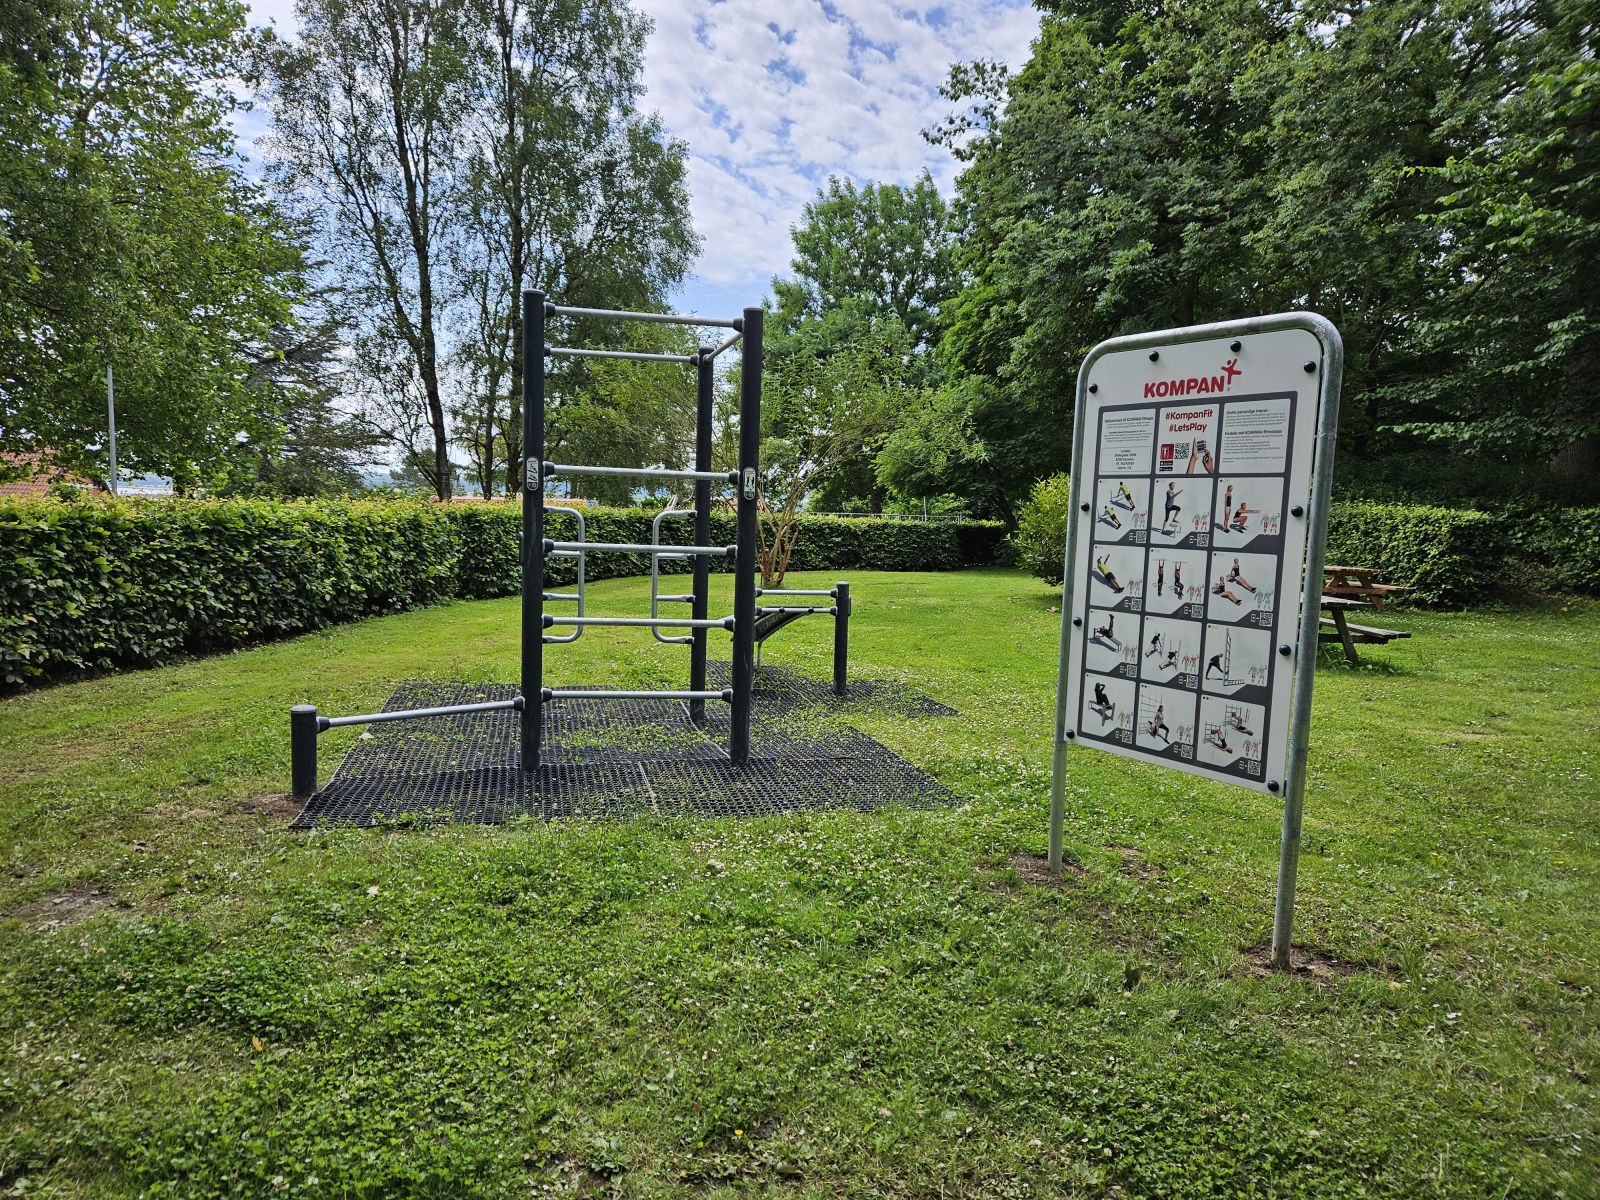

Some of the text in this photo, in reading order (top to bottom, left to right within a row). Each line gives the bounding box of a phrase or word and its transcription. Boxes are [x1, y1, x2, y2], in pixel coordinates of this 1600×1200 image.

[1144, 375, 1225, 399] KOMPAN
[1165, 409, 1213, 421] #KompanFit
[1168, 422, 1207, 432] #LetsPlay
